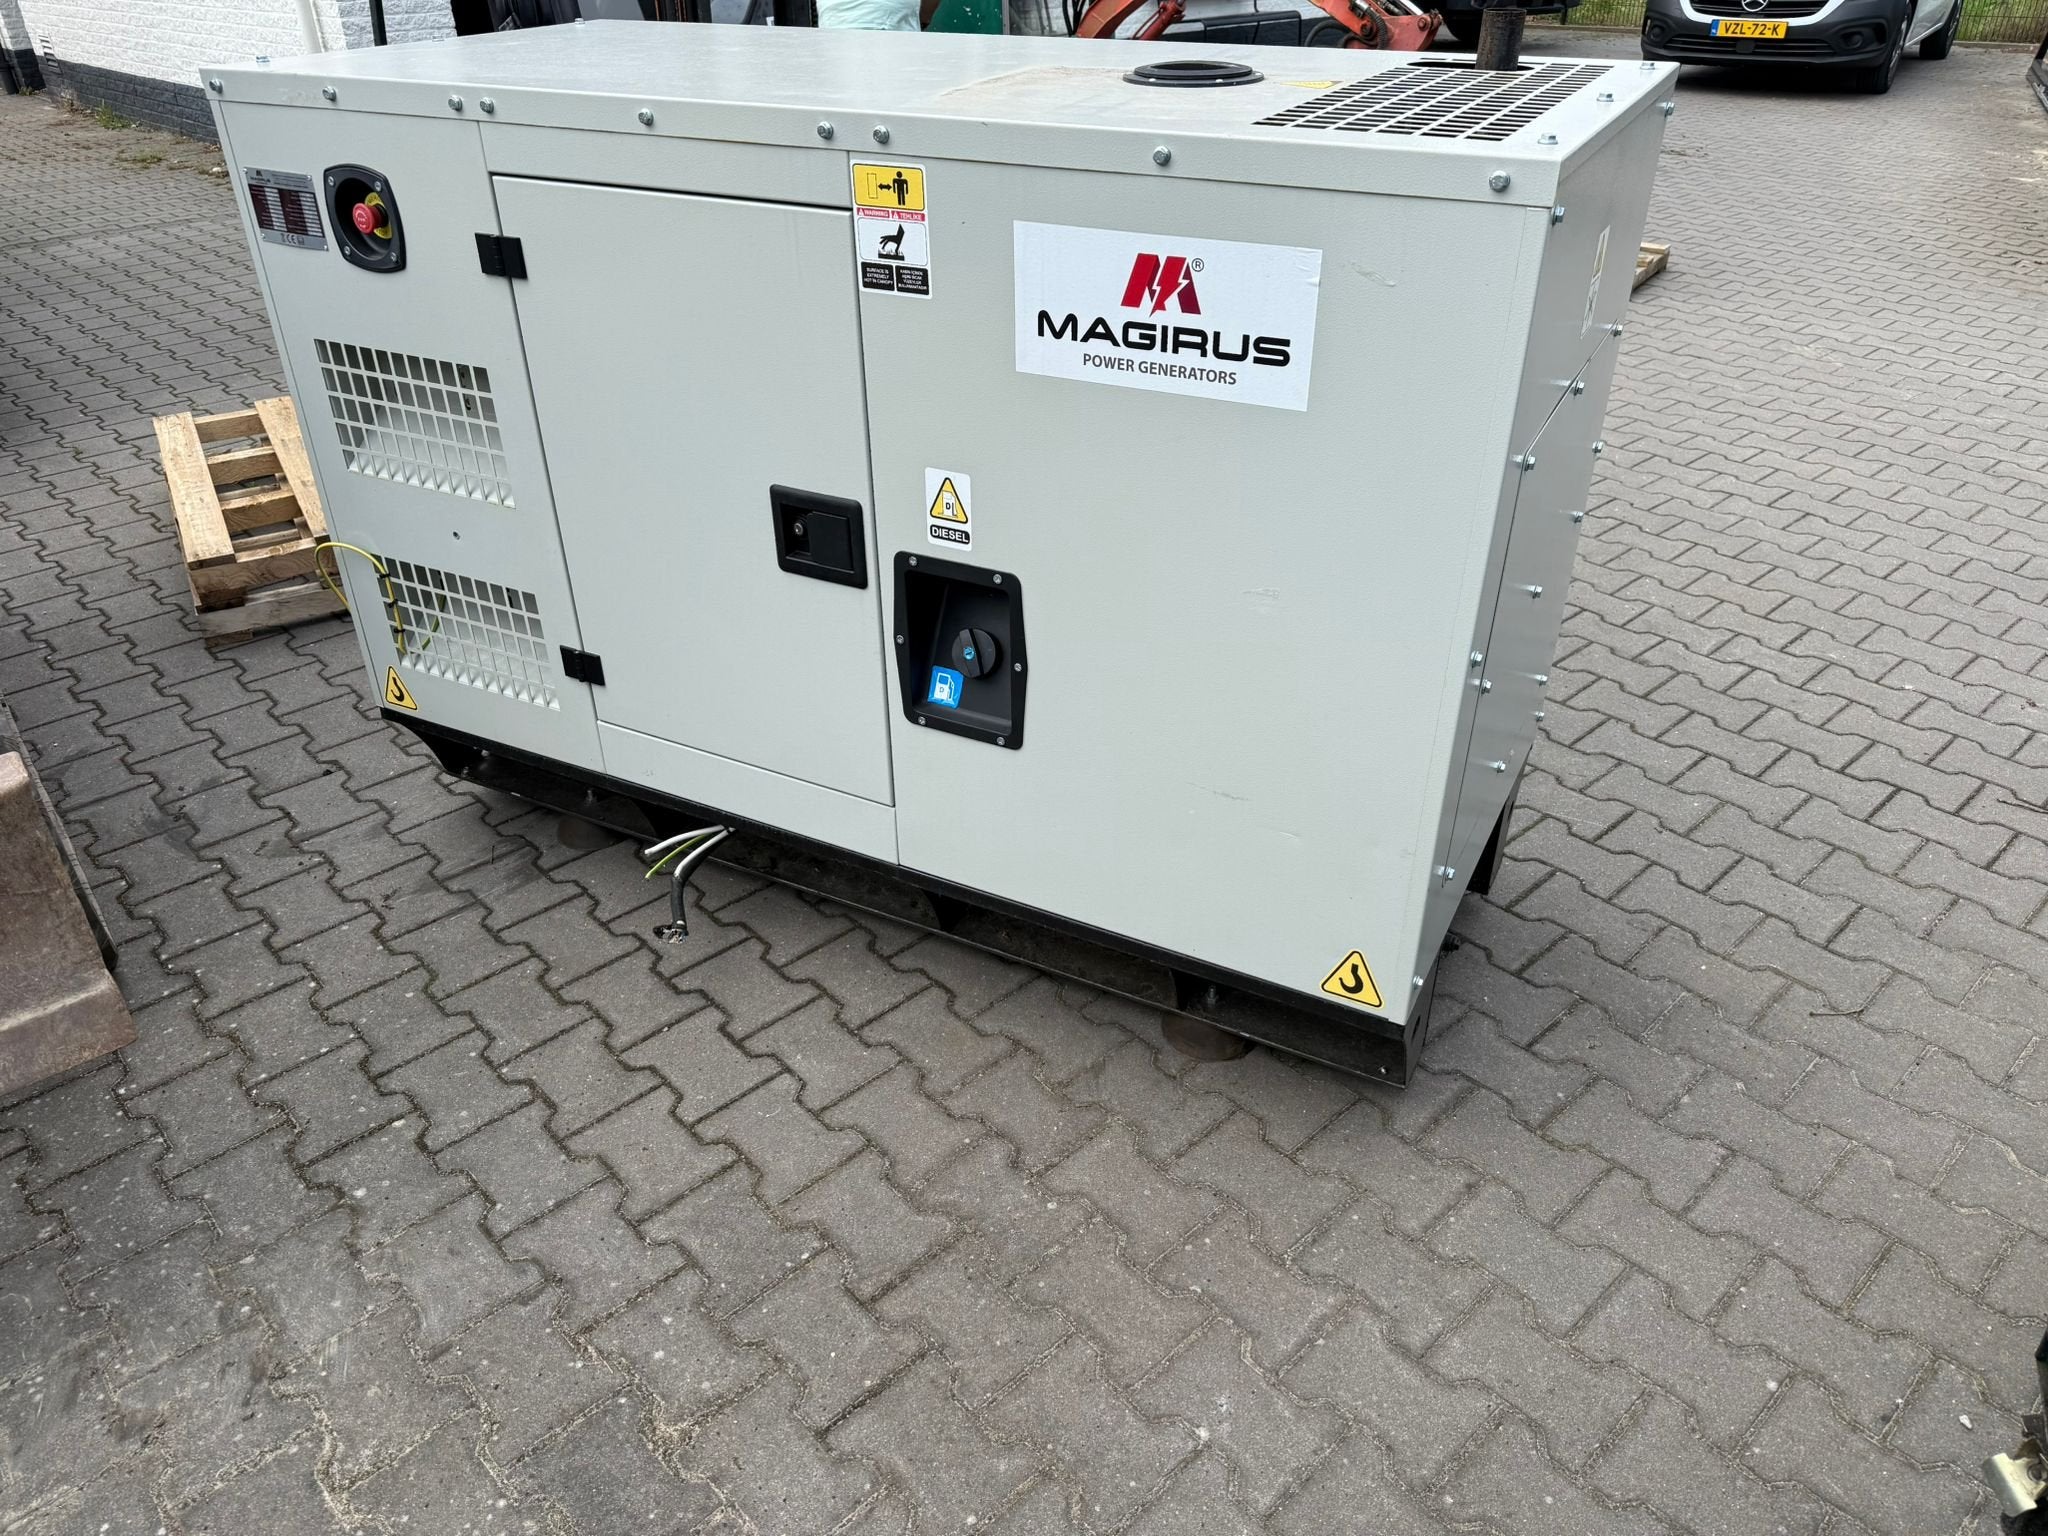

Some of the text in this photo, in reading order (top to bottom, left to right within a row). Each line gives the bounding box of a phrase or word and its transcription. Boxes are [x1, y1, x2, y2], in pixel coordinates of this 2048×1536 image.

[1724, 22, 1781, 36] VZL-72-K
[863, 209, 889, 218] WARNING
[1037, 309, 1291, 367] MAGIRUS
[1083, 353, 1237, 386] POWER GENERATORS
[931, 526, 969, 543] DIESEL
